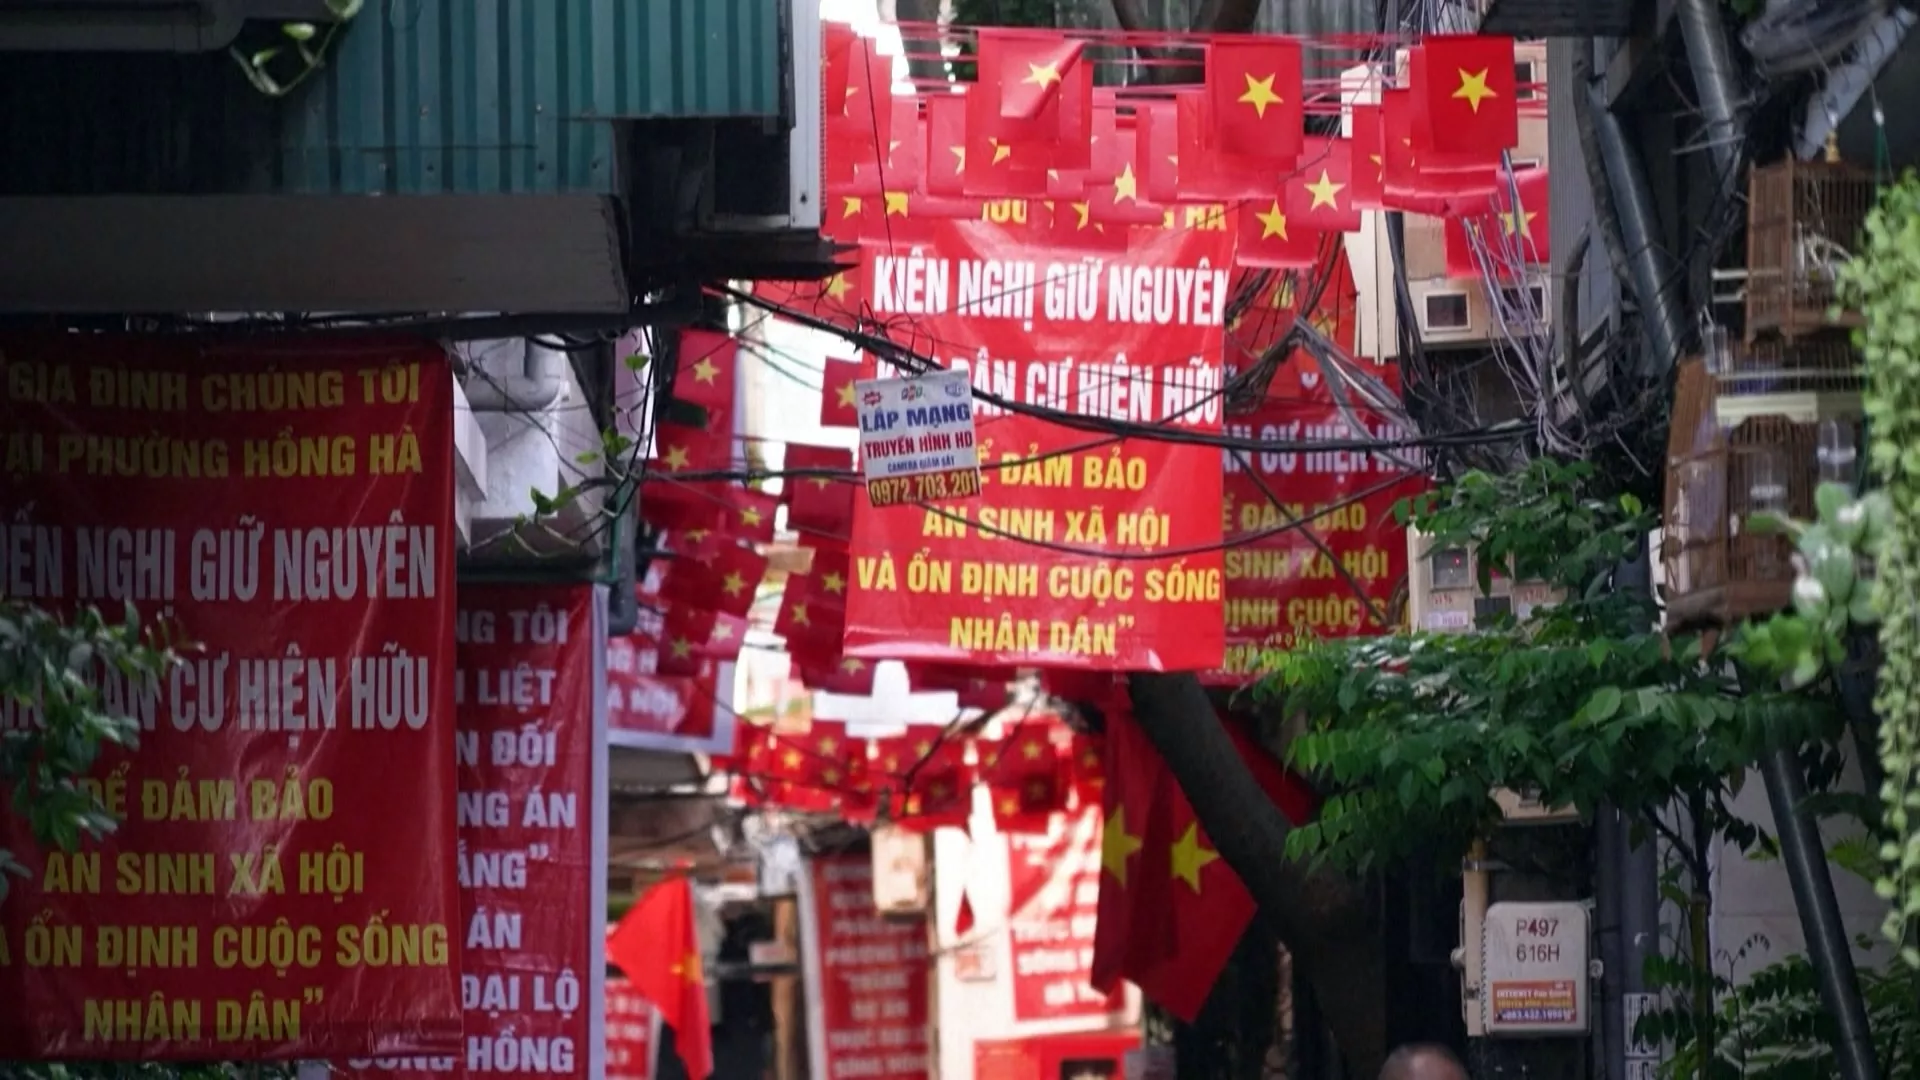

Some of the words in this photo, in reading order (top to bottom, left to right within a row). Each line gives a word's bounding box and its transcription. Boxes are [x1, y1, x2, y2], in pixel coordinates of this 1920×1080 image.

[958, 259, 1035, 332] NGHỊ
[1044, 255, 1103, 322] GIỮ
[8, 361, 76, 403] GIA
[89, 359, 187, 411] ĐÌNH
[203, 364, 344, 412] CHÚNG
[357, 362, 420, 403] TÔI
[906, 402, 970, 428] MẠNG
[0, 433, 43, 481] ẠI
[57, 430, 230, 478] PHƯỜNG
[243, 426, 356, 477] HỒNG
[369, 425, 423, 474] HÀ
[955, 431, 973, 449] HD
[870, 471, 978, 504] 0972.703.201
[1001, 443, 1073, 487] ĐẢM
[1083, 446, 1147, 491] BẢO
[923, 506, 966, 539] AN
[977, 506, 1054, 545] SINH
[1065, 506, 1107, 545] XÃ
[1116, 511, 1170, 552] HỘI
[0, 502, 63, 597] IẾN
[77, 527, 175, 617] NGHỊ
[190, 514, 264, 600] GIỮ
[274, 510, 435, 600] NGUYÊN
[857, 551, 897, 592] VÀ
[907, 547, 952, 593] ỔN
[962, 563, 1038, 602] ĐỊNH
[1049, 564, 1134, 606] CUỘC
[1145, 560, 1220, 602] SỐNG
[1344, 545, 1389, 585] HỘI
[507, 603, 569, 644] TÔI
[949, 613, 1041, 653] NHÂN
[170, 651, 229, 732] CƯ
[239, 643, 336, 748] HIỆN
[350, 642, 429, 730] HỮU
[478, 661, 557, 713] LIỆT
[491, 718, 558, 768] ĐỐI
[142, 765, 236, 821] ĐẢM
[252, 765, 334, 821] BẢO
[522, 784, 577, 828] ÁN
[43, 851, 100, 894] AN
[116, 851, 215, 895] SINH
[229, 844, 285, 895] XÃ
[301, 842, 364, 903] HỘI
[25, 909, 82, 967] ỔN
[97, 926, 198, 977] ĐỊNH
[213, 916, 322, 978] CUỘC
[336, 909, 448, 967] SỐNG
[467, 905, 522, 950] ÁN
[1516, 919, 1559, 938] P497
[1516, 944, 1560, 963] 616H
[84, 991, 200, 1041] NHÂN
[533, 967, 580, 1019] LỘ
[467, 1025, 575, 1074] HỒNG
